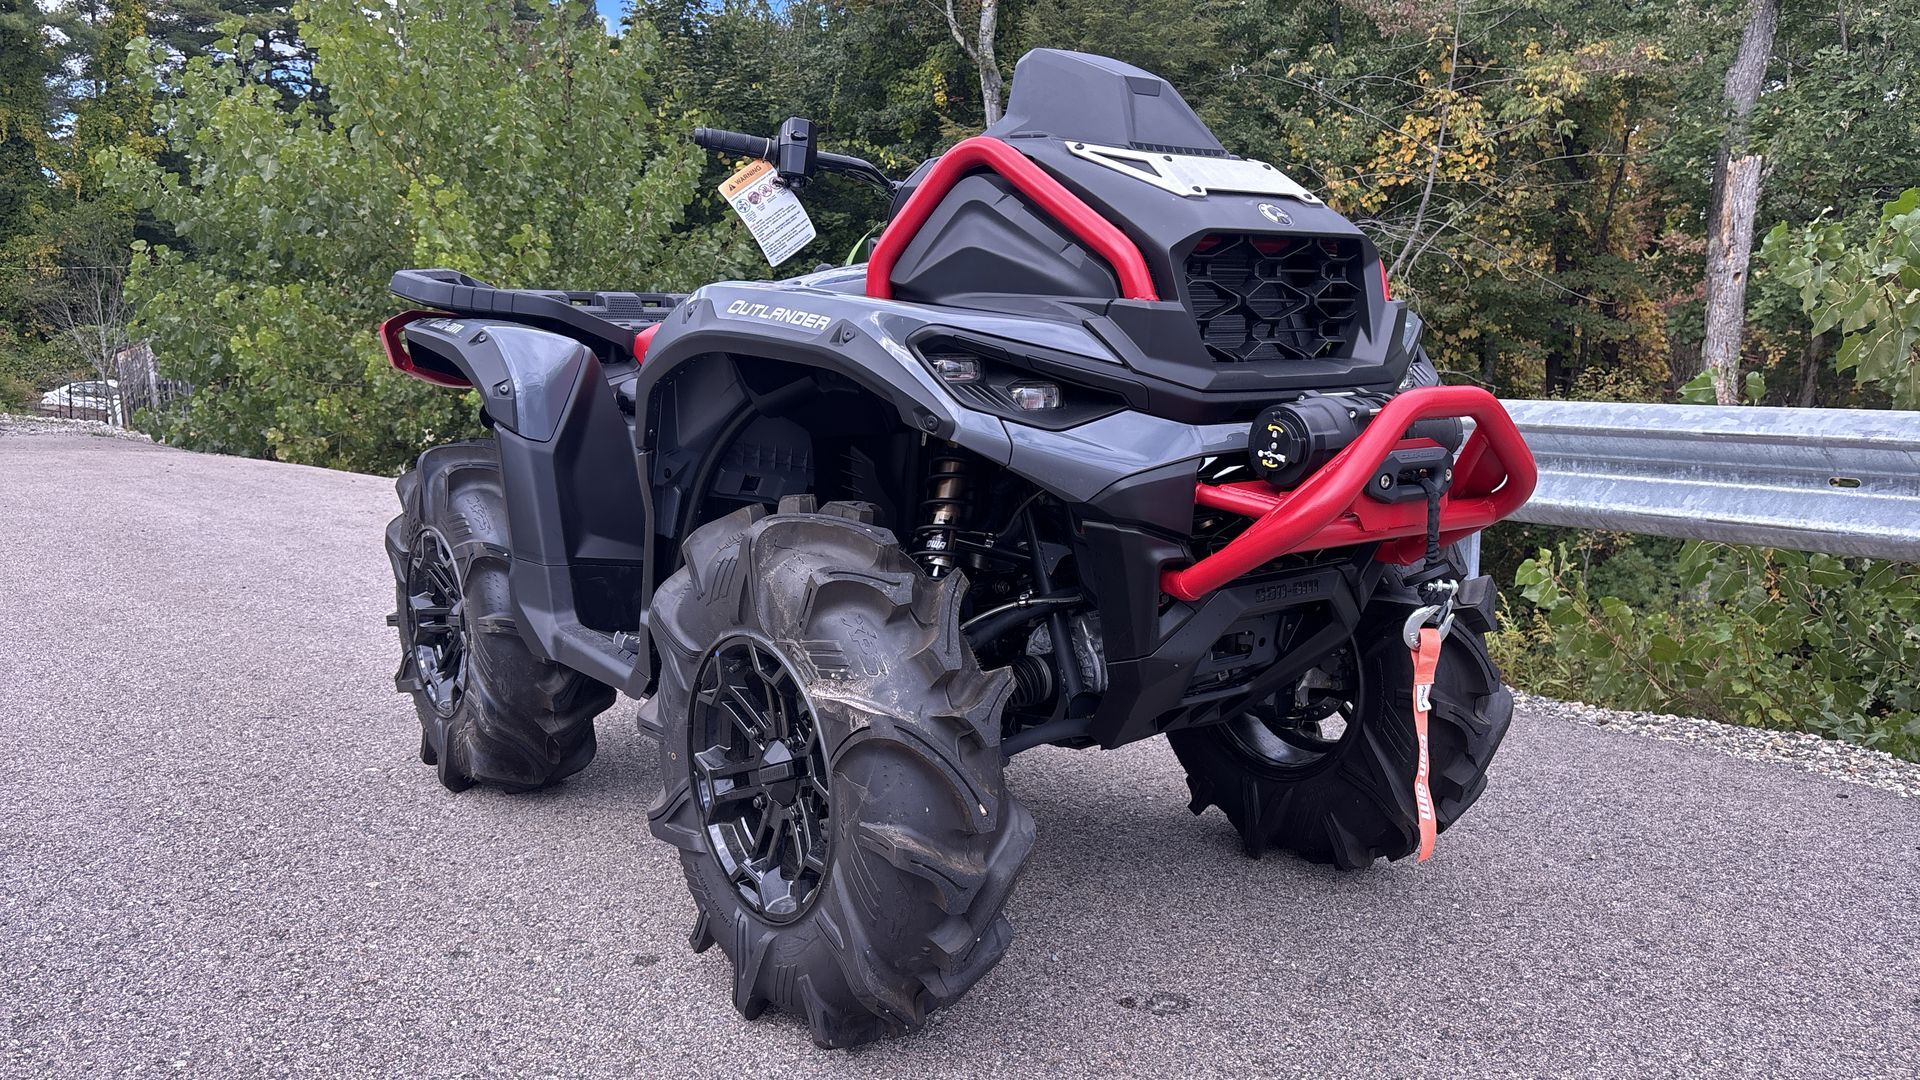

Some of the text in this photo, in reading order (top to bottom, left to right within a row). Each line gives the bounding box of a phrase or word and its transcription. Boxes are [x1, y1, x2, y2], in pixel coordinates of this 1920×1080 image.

[735, 164, 762, 185] WARNING
[727, 299, 831, 330] OUTLANDER
[1416, 733, 1432, 820] can-am
